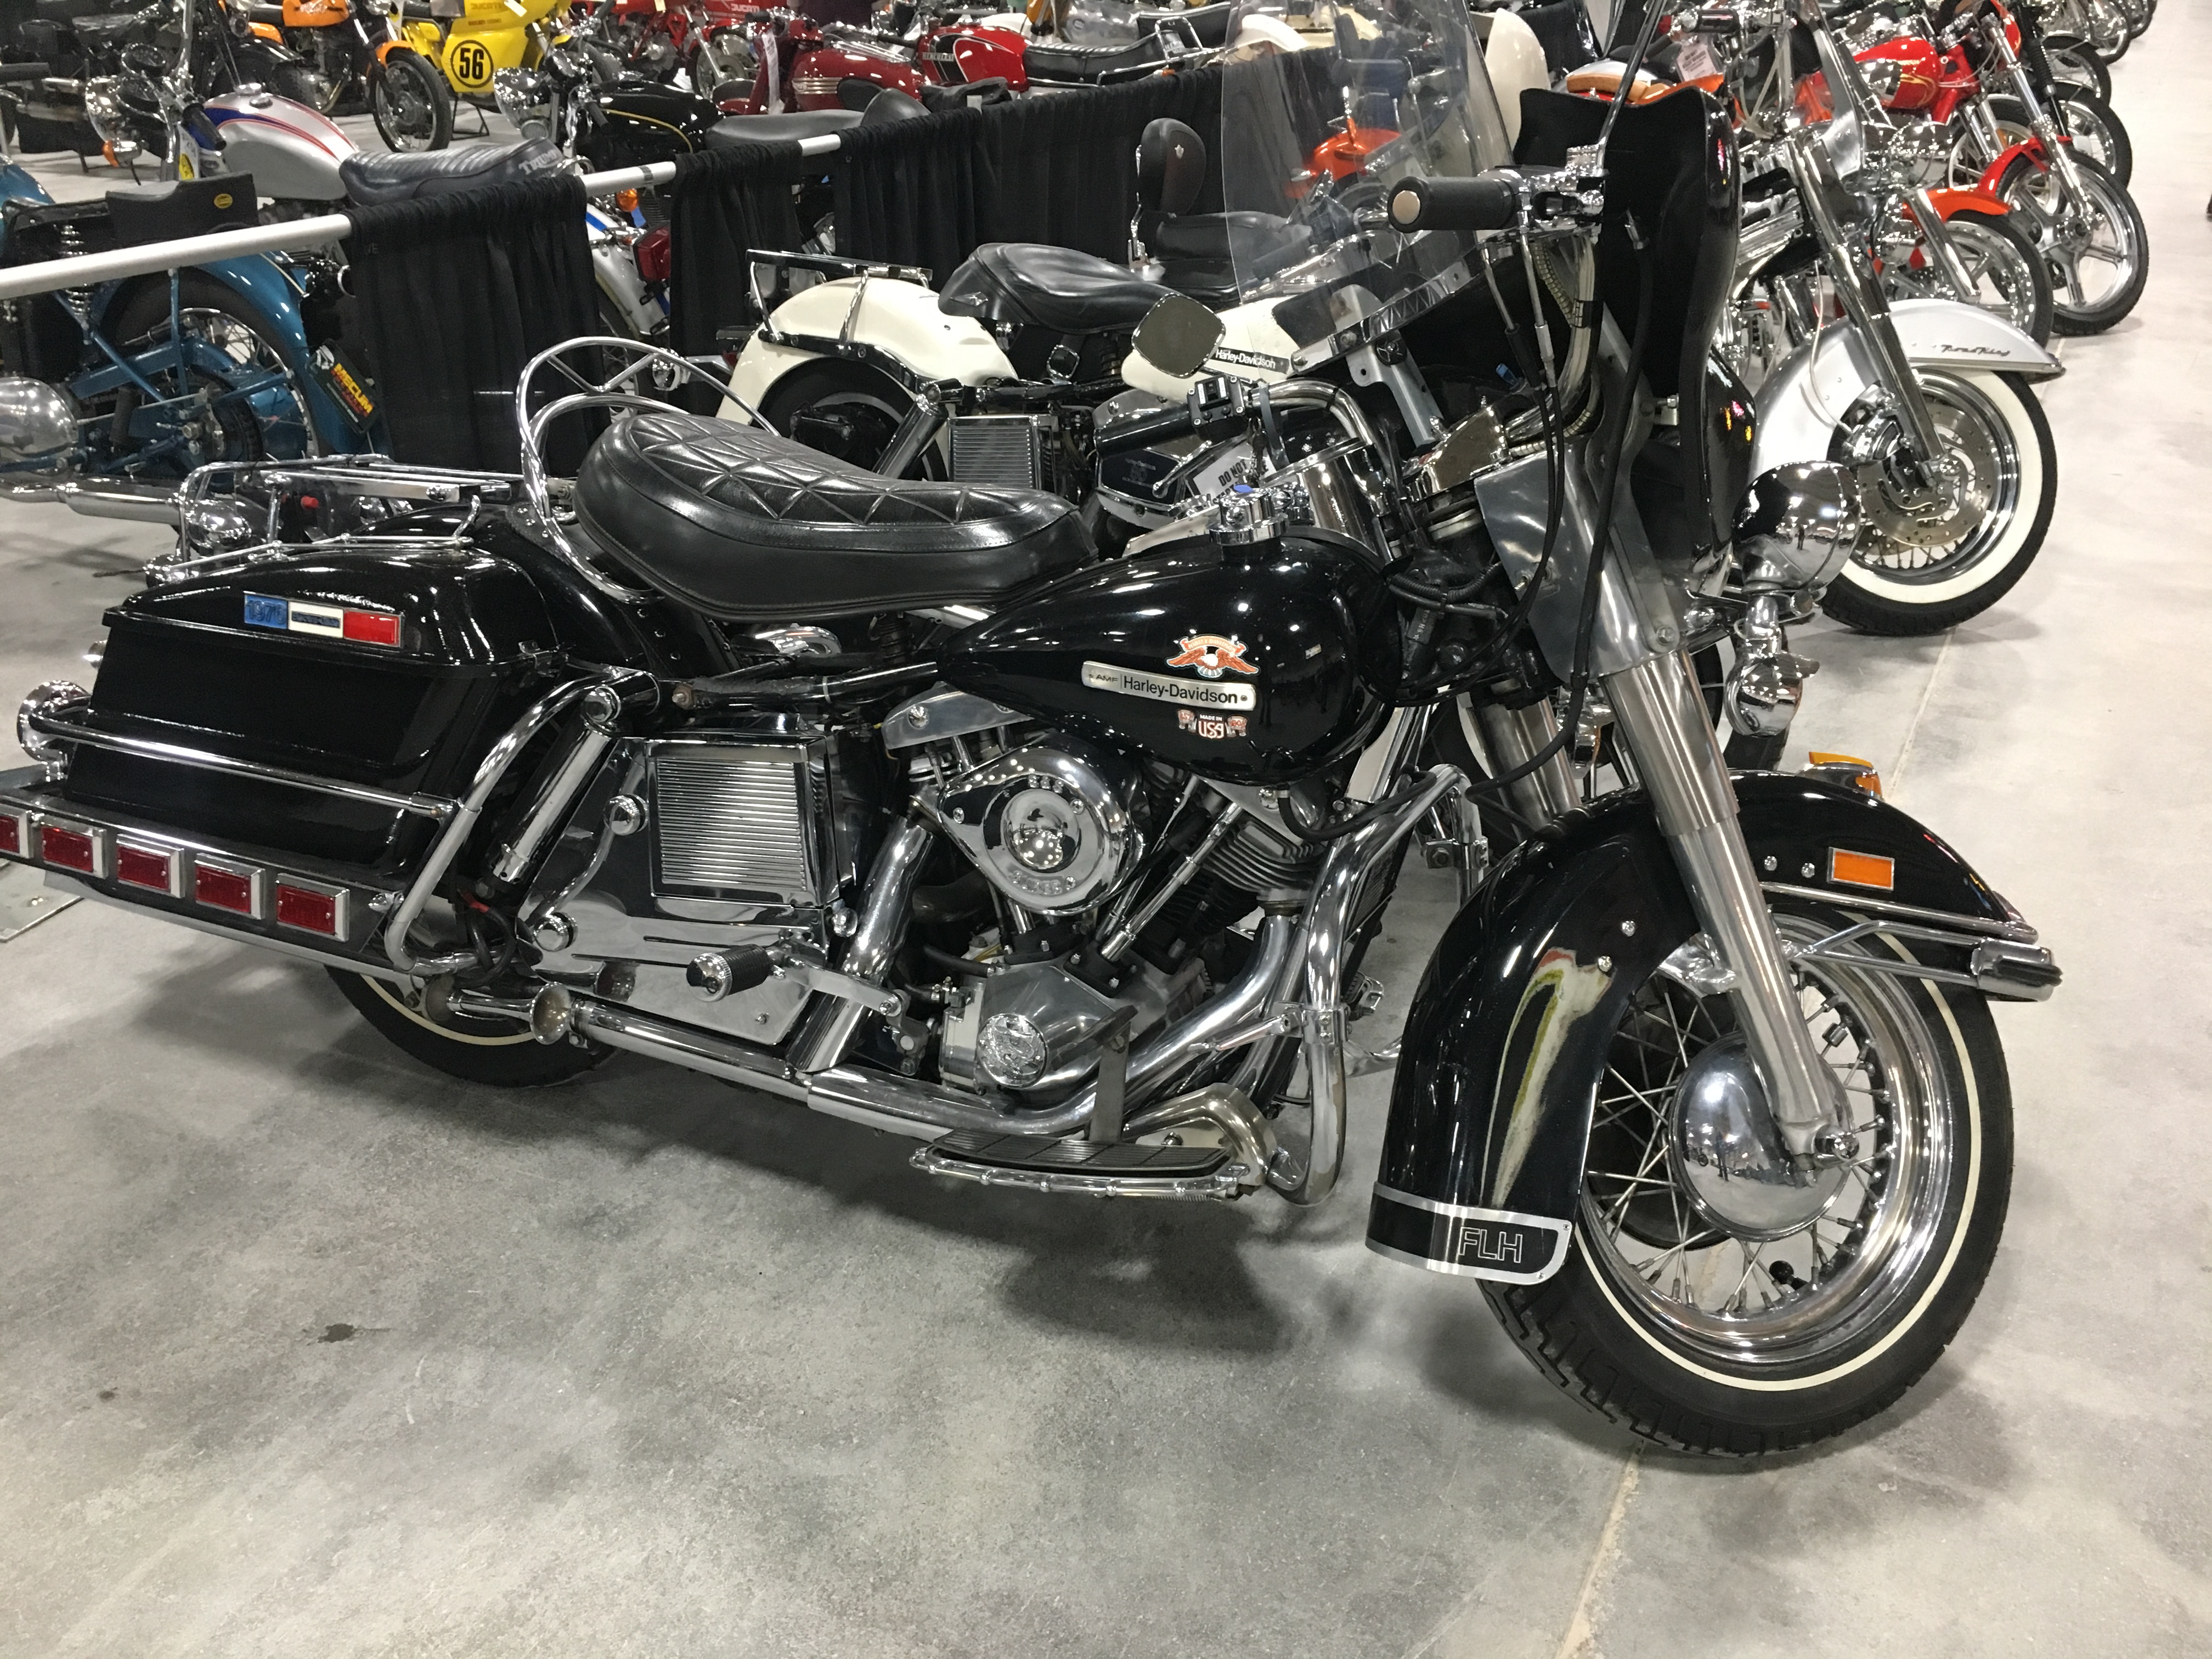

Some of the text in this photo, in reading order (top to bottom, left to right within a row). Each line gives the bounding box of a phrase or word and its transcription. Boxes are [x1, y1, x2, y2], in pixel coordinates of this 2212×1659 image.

[459, 47, 484, 80] 56
[1215, 348, 1276, 369] Harley-Davidson
[334, 363, 373, 414] MECUM
[1218, 471, 1232, 487] DO
[1230, 458, 1248, 478] NOT
[246, 600, 286, 625] 1976
[1096, 674, 1238, 704] AMF Harley-Davidson
[1199, 720, 1224, 738] USA
[1458, 1226, 1523, 1263] FLH
